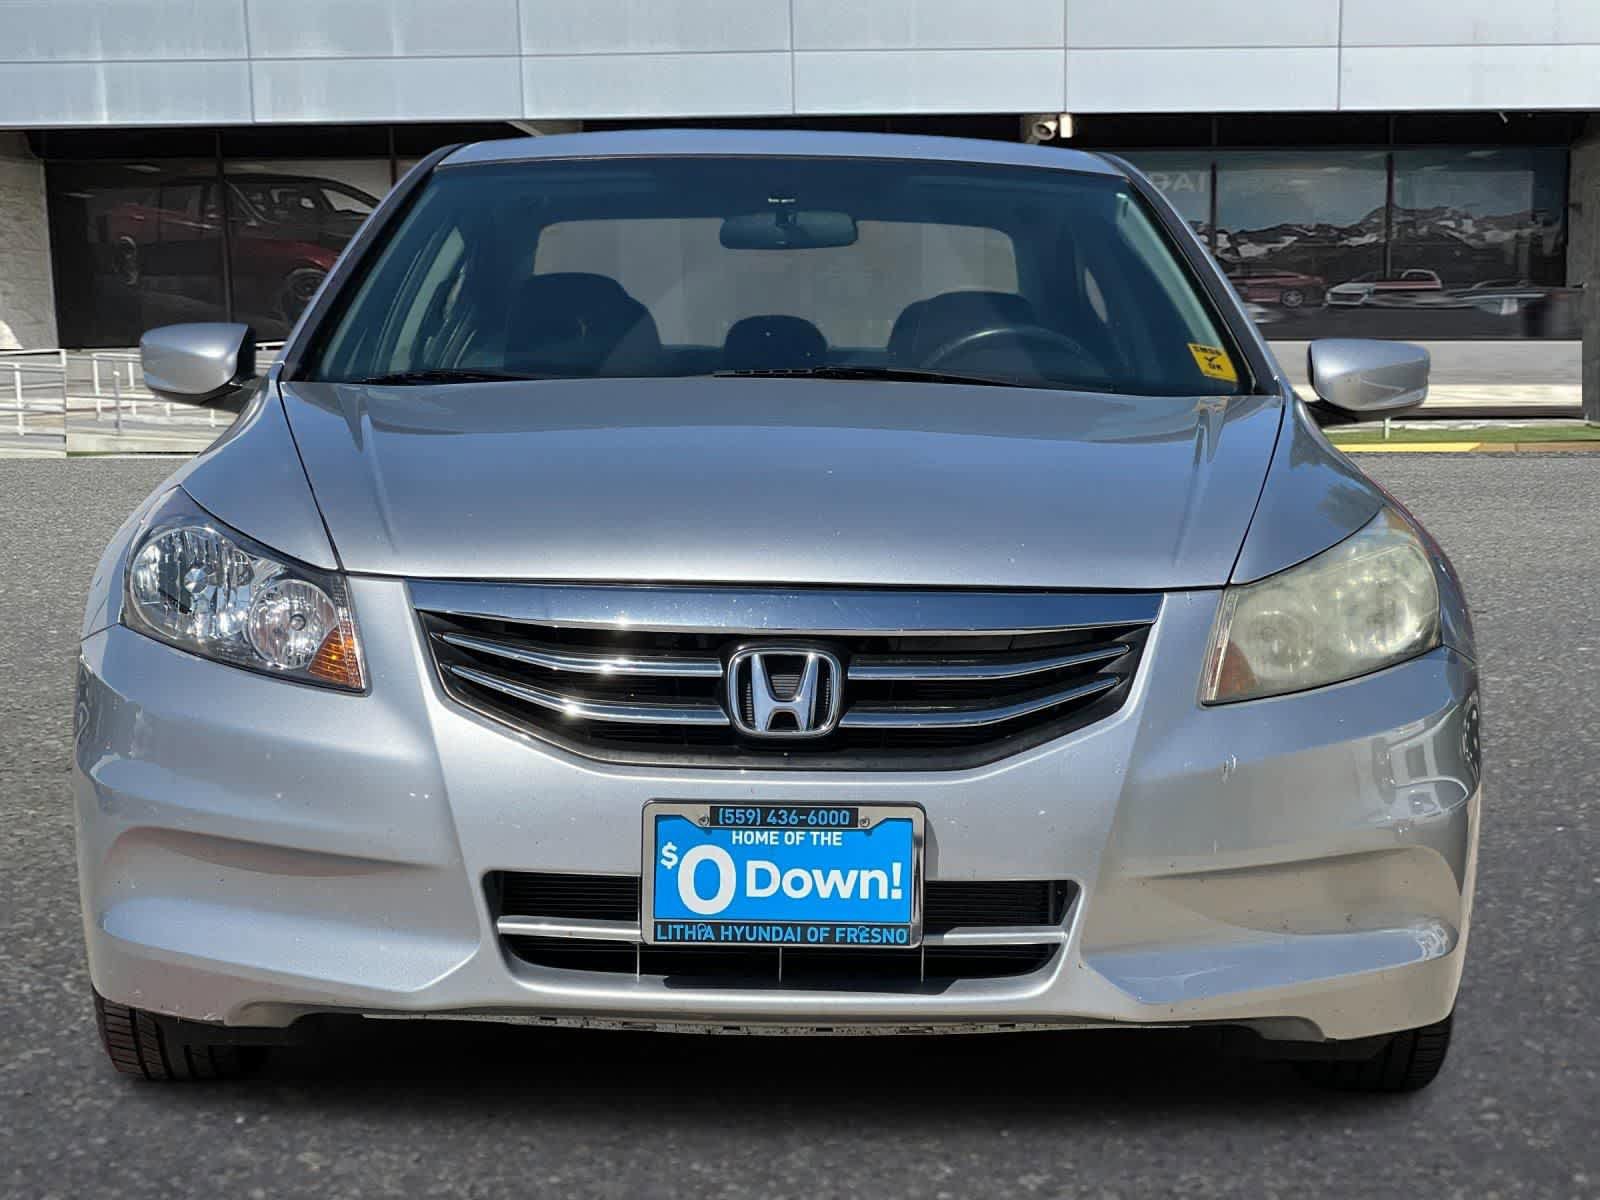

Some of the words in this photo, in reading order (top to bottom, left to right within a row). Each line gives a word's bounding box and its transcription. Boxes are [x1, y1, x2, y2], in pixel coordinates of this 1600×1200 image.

[718, 808, 761, 826] (559)
[767, 808, 850, 825] 436-6000
[732, 830, 779, 845] HOME
[784, 831, 807, 845] OF
[810, 831, 843, 846] THE
[745, 860, 903, 899] Down!
[722, 926, 802, 942] HYUNDAI
[807, 926, 831, 943] OF
[835, 927, 907, 943] FRESNO
